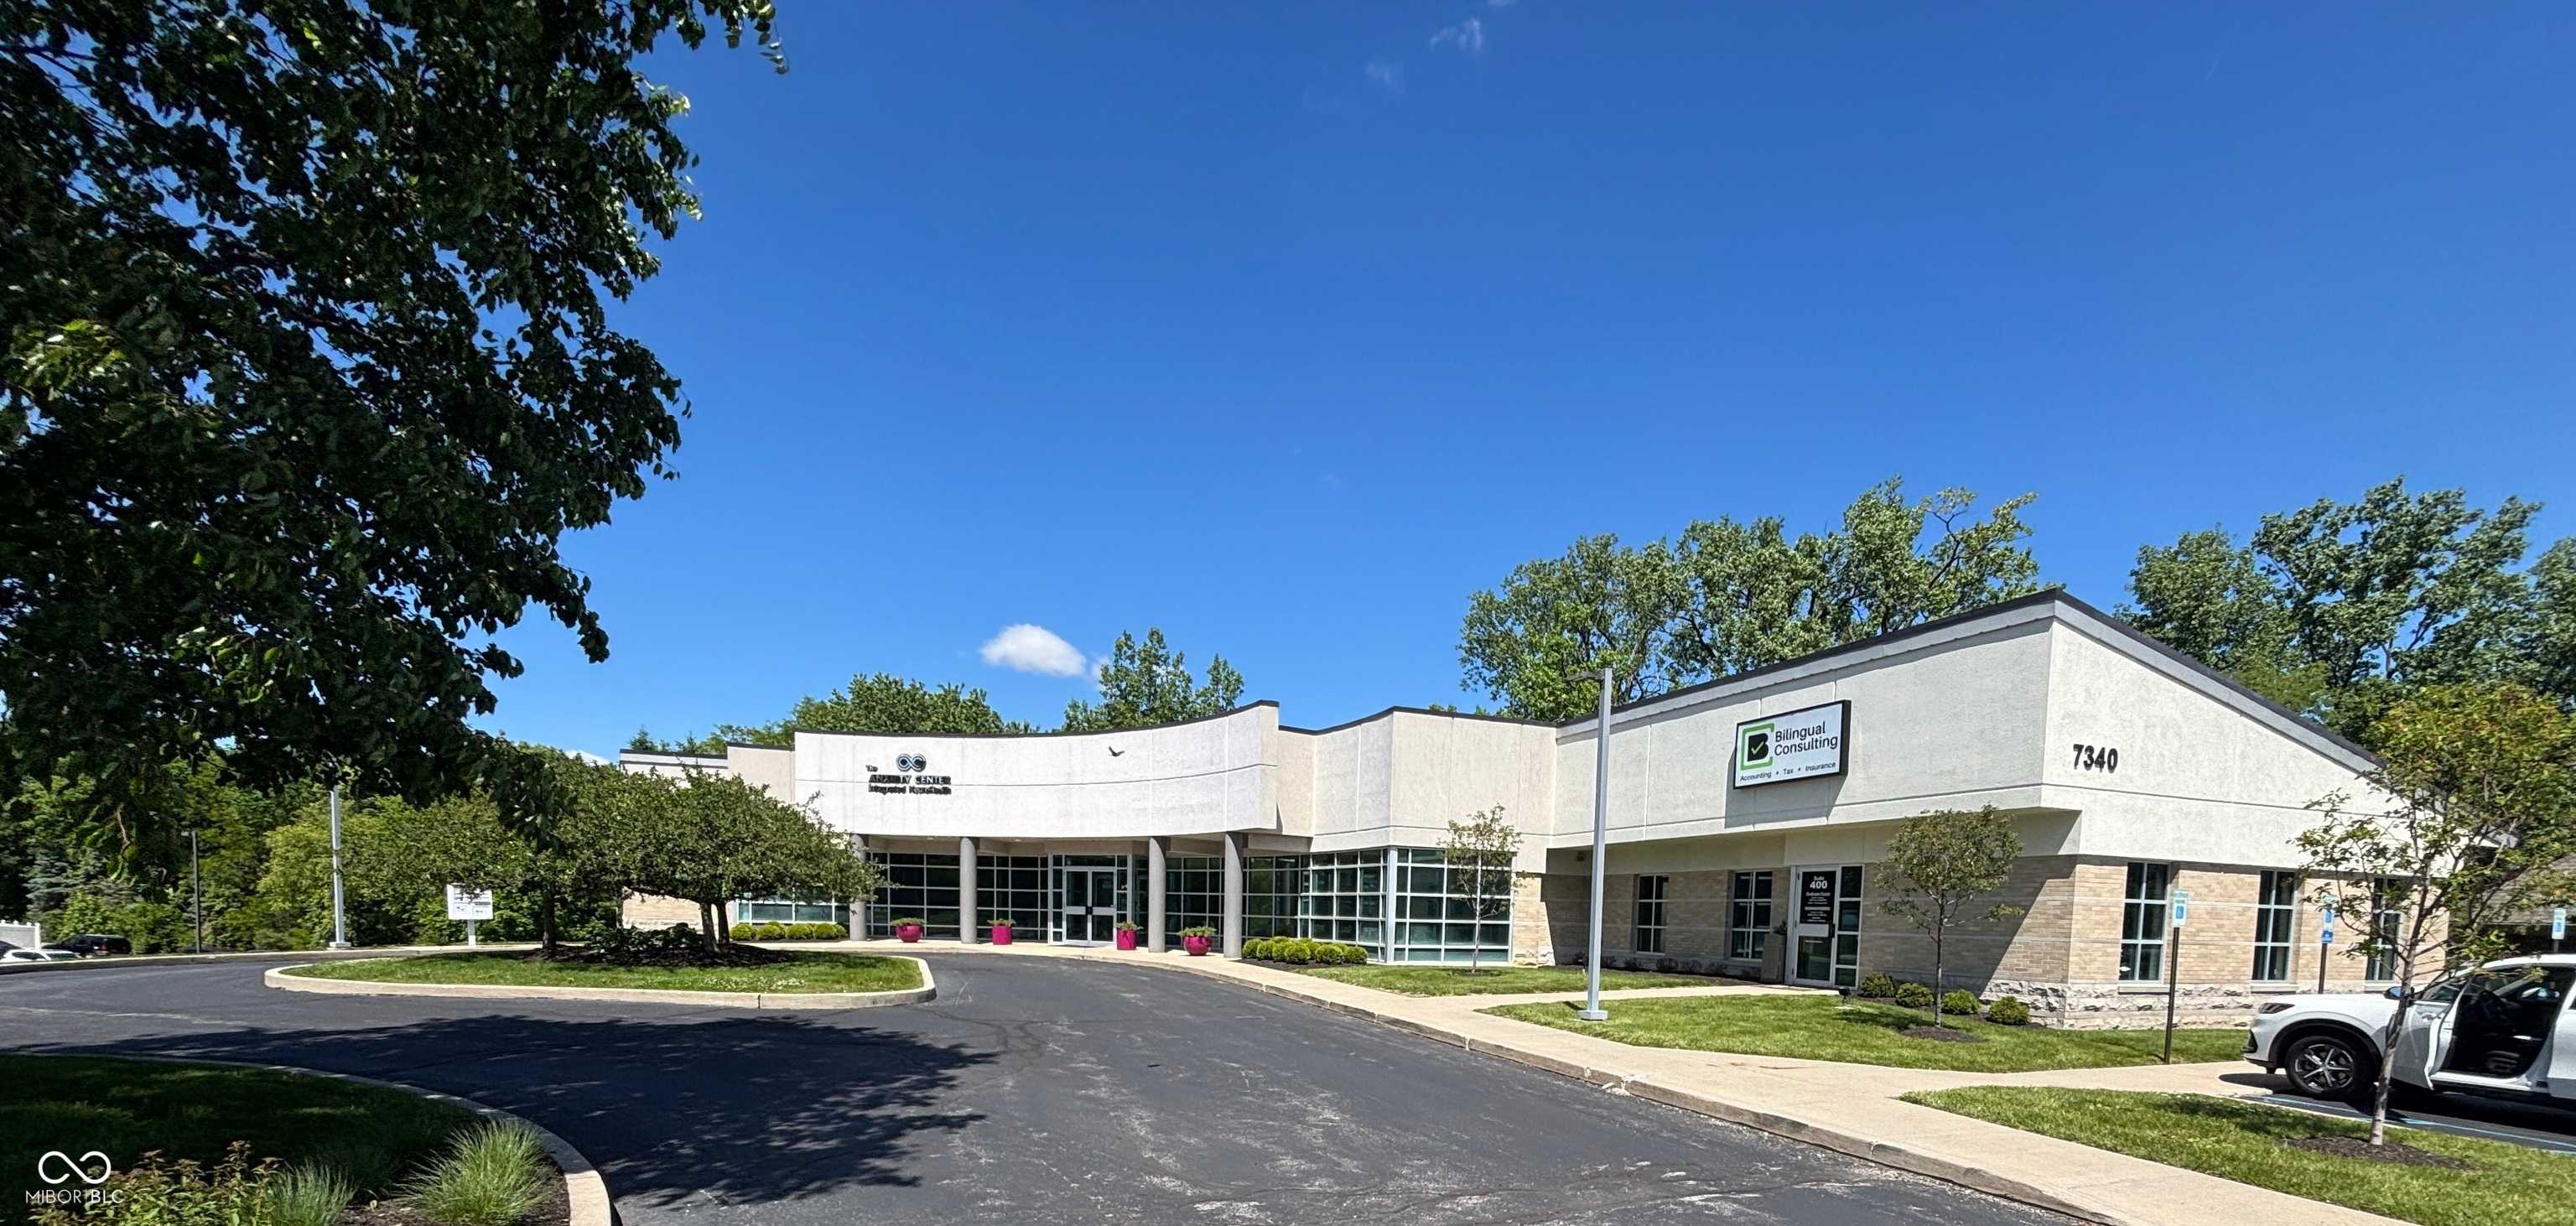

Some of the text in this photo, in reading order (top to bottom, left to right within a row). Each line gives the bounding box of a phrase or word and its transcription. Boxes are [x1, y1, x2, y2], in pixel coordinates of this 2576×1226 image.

[1775, 720, 1826, 743] Bilingual
[1774, 735, 1838, 756] Consulting
[2073, 743, 2118, 773] 7340
[869, 774, 952, 785] ANXIETY CENTER
[1740, 771, 1772, 782] Accounting
[1805, 761, 1836, 772] Insurance
[1810, 881, 1828, 889] 400
